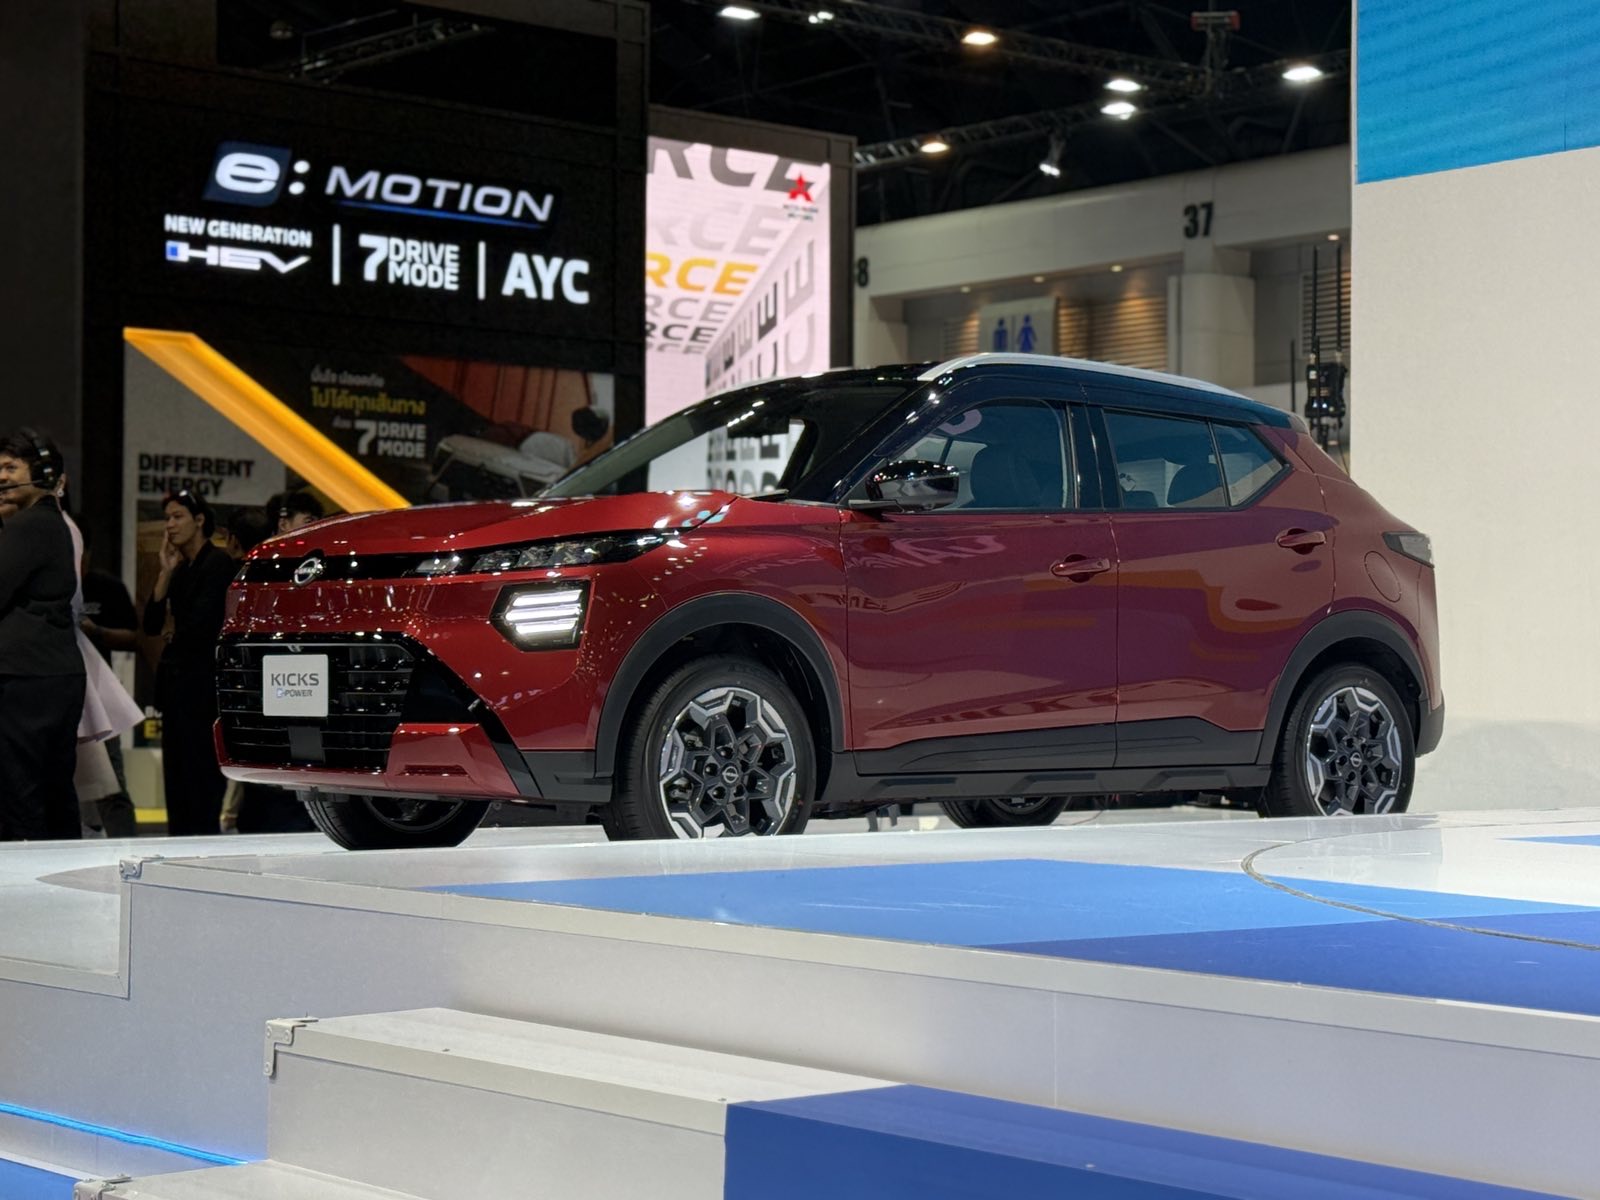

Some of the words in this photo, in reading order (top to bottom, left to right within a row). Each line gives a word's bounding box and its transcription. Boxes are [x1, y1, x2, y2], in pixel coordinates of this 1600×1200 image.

[325, 166, 554, 222] MOTION
[164, 214, 206, 235] NEW
[207, 219, 313, 248] GENERATION
[1184, 202, 1213, 239] 37
[359, 233, 388, 281] 7
[389, 238, 460, 265] DRIVE
[646, 252, 758, 296] RCE
[855, 256, 869, 288] 8
[388, 262, 460, 290] MODE
[501, 252, 590, 304] AYC
[354, 419, 377, 455] 7
[378, 421, 426, 440] DRIVE
[377, 439, 425, 458] MODE
[138, 452, 255, 478] DIFFERENT
[138, 474, 223, 497] ENERGY
[271, 672, 320, 686] KICKS
